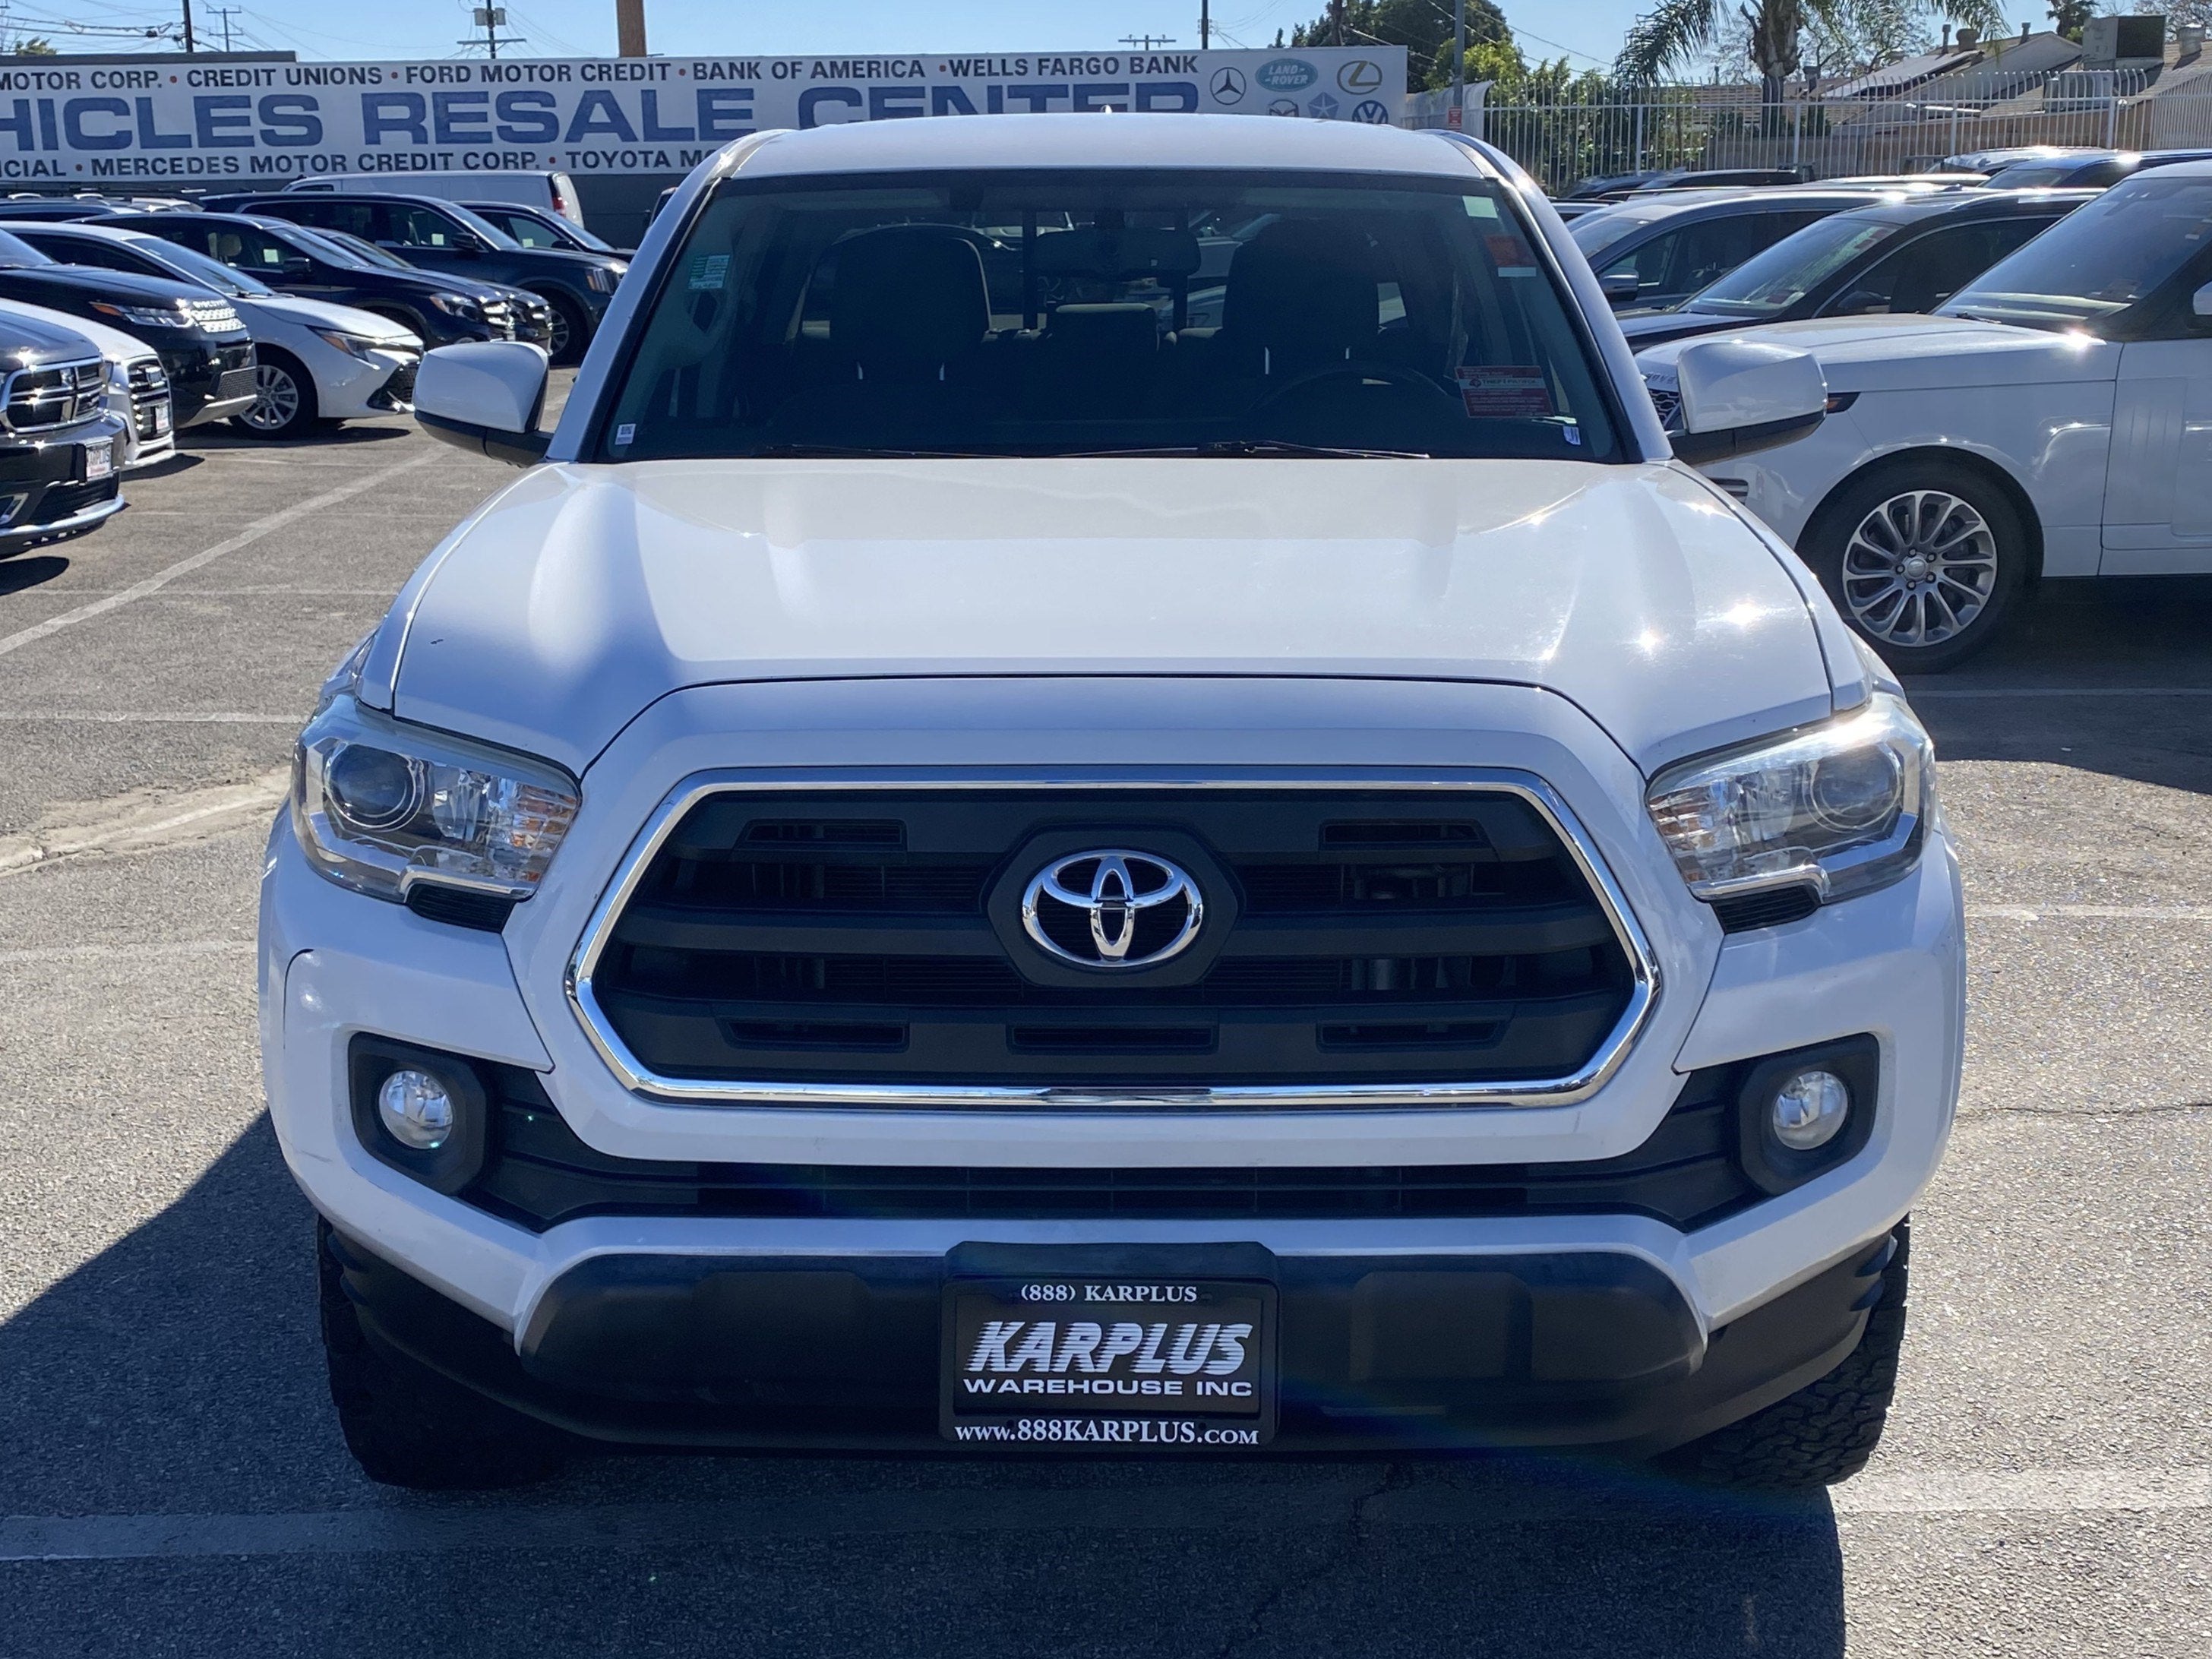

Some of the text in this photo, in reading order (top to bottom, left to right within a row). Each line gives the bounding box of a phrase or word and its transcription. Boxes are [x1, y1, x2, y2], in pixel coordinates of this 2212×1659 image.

[90, 70, 163, 89] CORP.
[187, 68, 276, 87] CREDIT
[286, 66, 382, 86] UNIONS
[406, 65, 471, 84] FORD
[481, 63, 574, 83] MOTOR
[580, 62, 672, 81] CREDIT
[693, 62, 763, 81] BANK
[771, 61, 803, 79] OF
[810, 59, 926, 79] AMERICA
[949, 58, 1028, 77] WELLS
[1038, 57, 1120, 76] FARGO
[1130, 55, 1199, 74] BANK
[361, 88, 755, 145] RESALE
[0, 159, 67, 178] CIAL
[90, 156, 240, 177] MERCEDES
[251, 153, 347, 174] MOTOR
[358, 152, 454, 172] CREDIT
[463, 151, 540, 171] CORP.
[566, 150, 671, 169] TOYOTA
[1021, 1285, 1198, 1303] (888) KARPLUS
[964, 1320, 1253, 1376] KARPLUS
[963, 1378, 1253, 1397] WAREHOUSE INC
